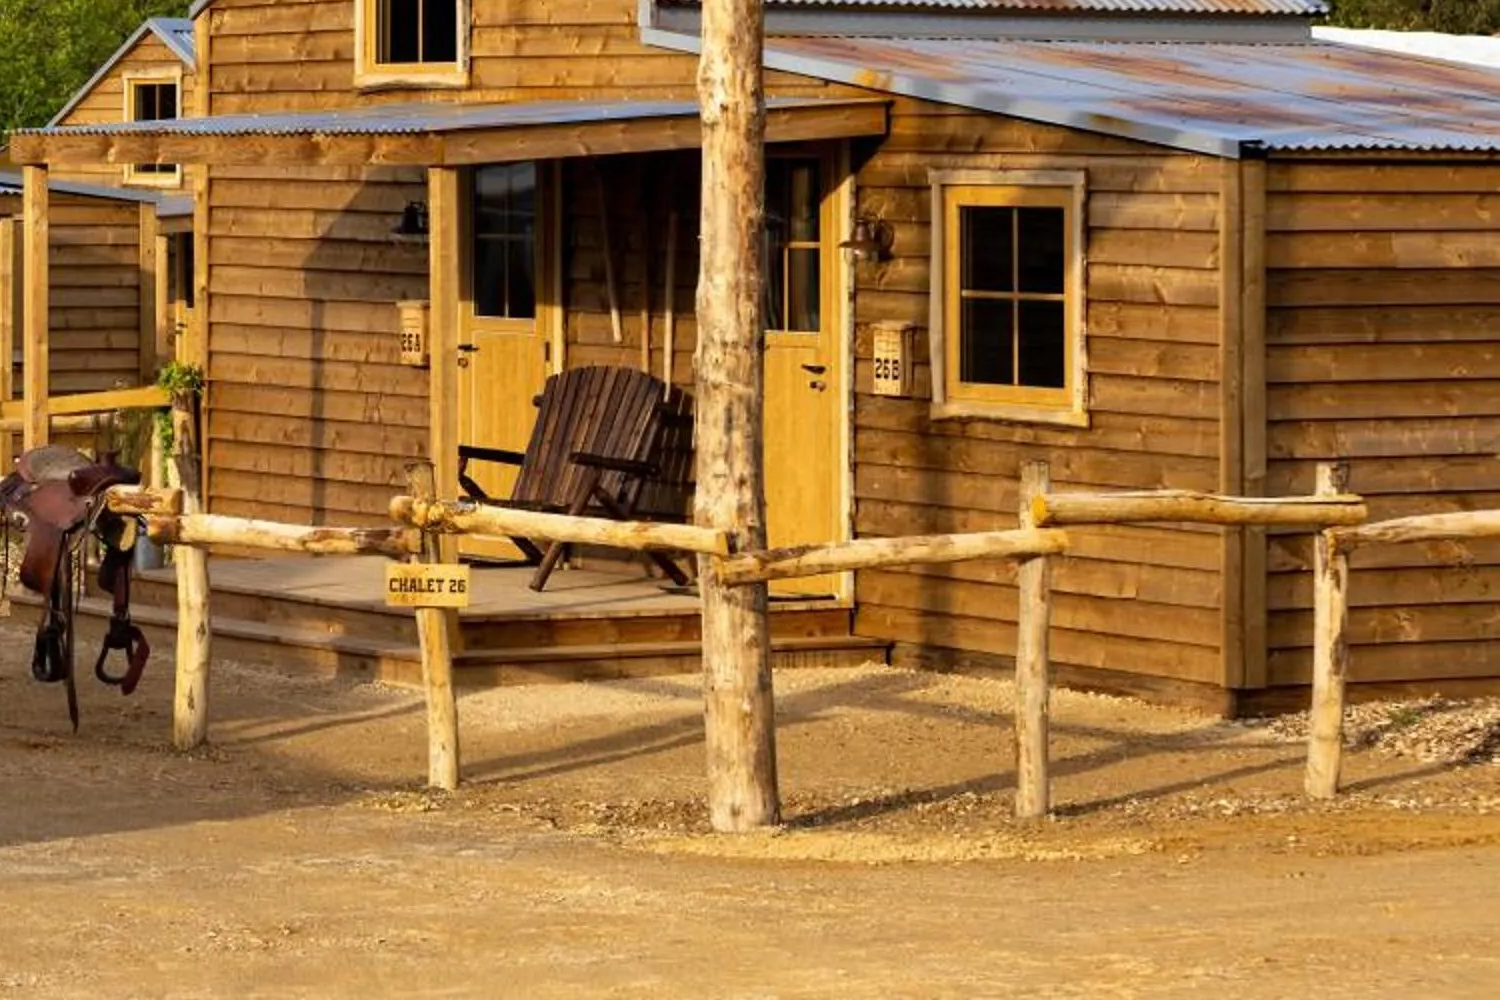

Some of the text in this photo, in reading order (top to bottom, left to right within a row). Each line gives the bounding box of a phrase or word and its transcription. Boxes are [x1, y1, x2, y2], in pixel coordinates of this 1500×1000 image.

[401, 332, 421, 352] 26A
[875, 357, 900, 380] 26B
[389, 577, 466, 592] CHALET 26
